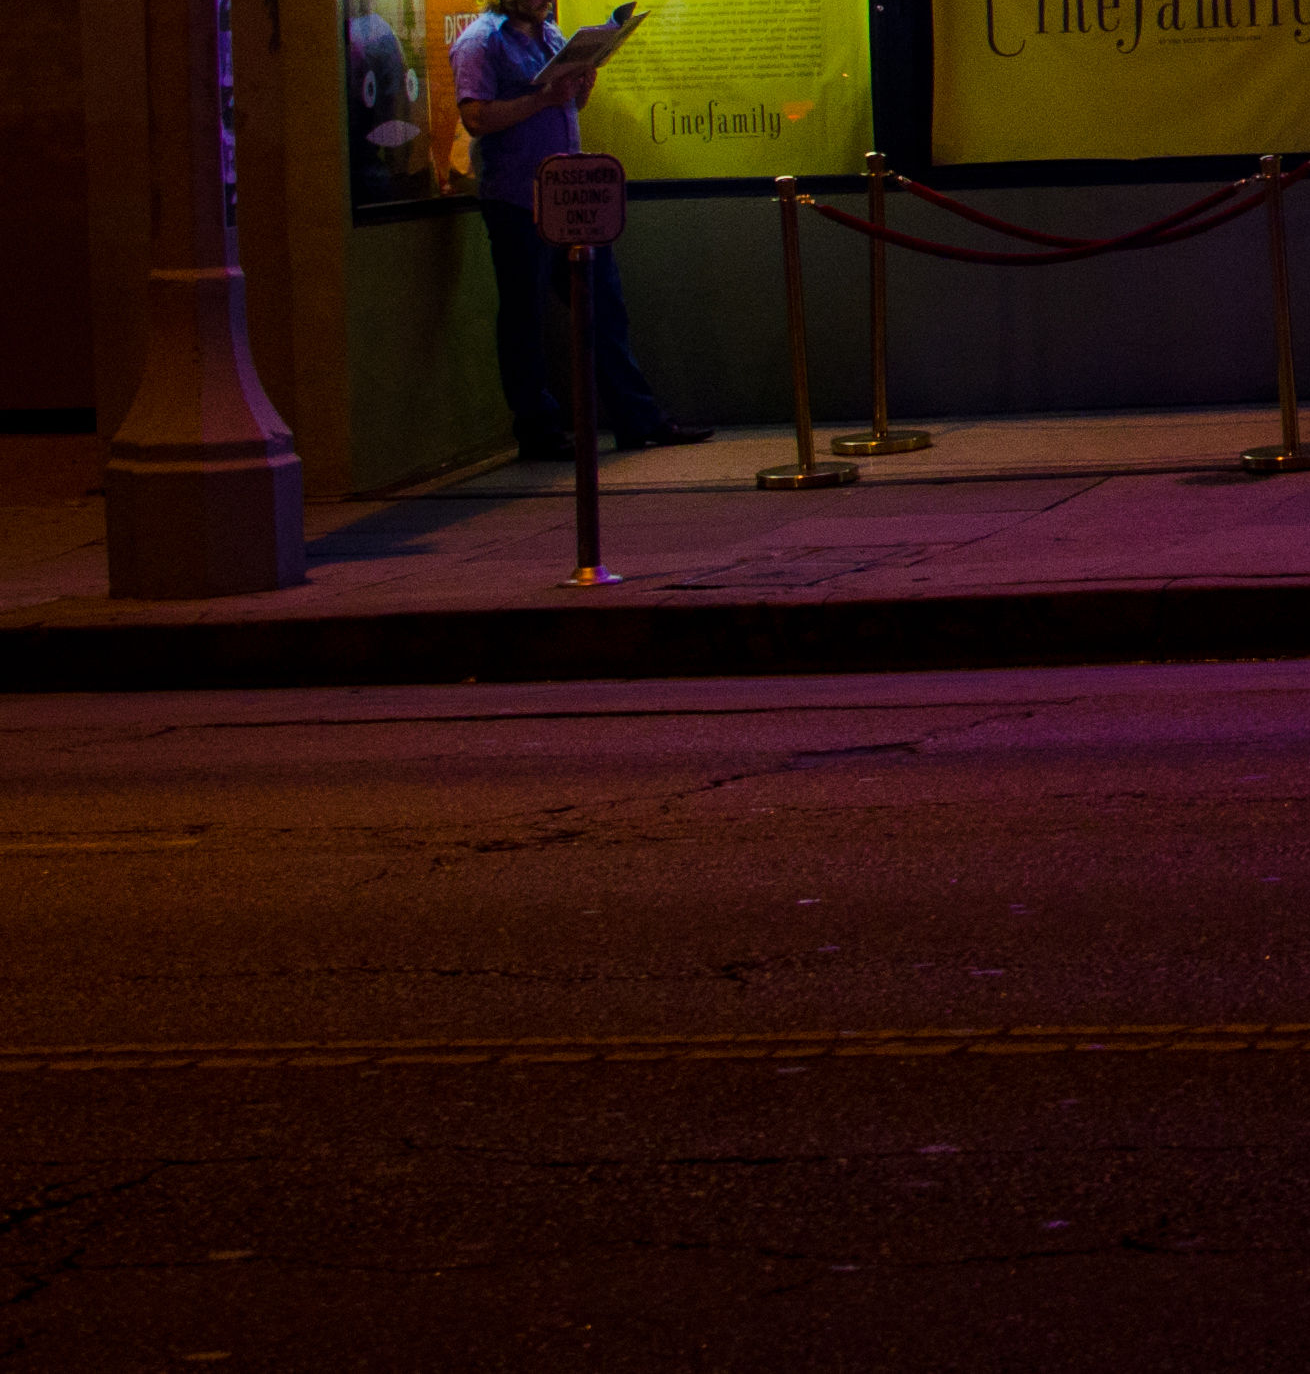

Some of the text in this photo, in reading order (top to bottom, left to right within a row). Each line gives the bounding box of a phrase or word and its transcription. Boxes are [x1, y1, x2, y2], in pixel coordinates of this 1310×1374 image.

[651, 99, 782, 145] Cinefamily
[545, 168, 617, 186] PASSENGER
[553, 188, 609, 205] LOADING
[566, 209, 598, 225] ONLY
